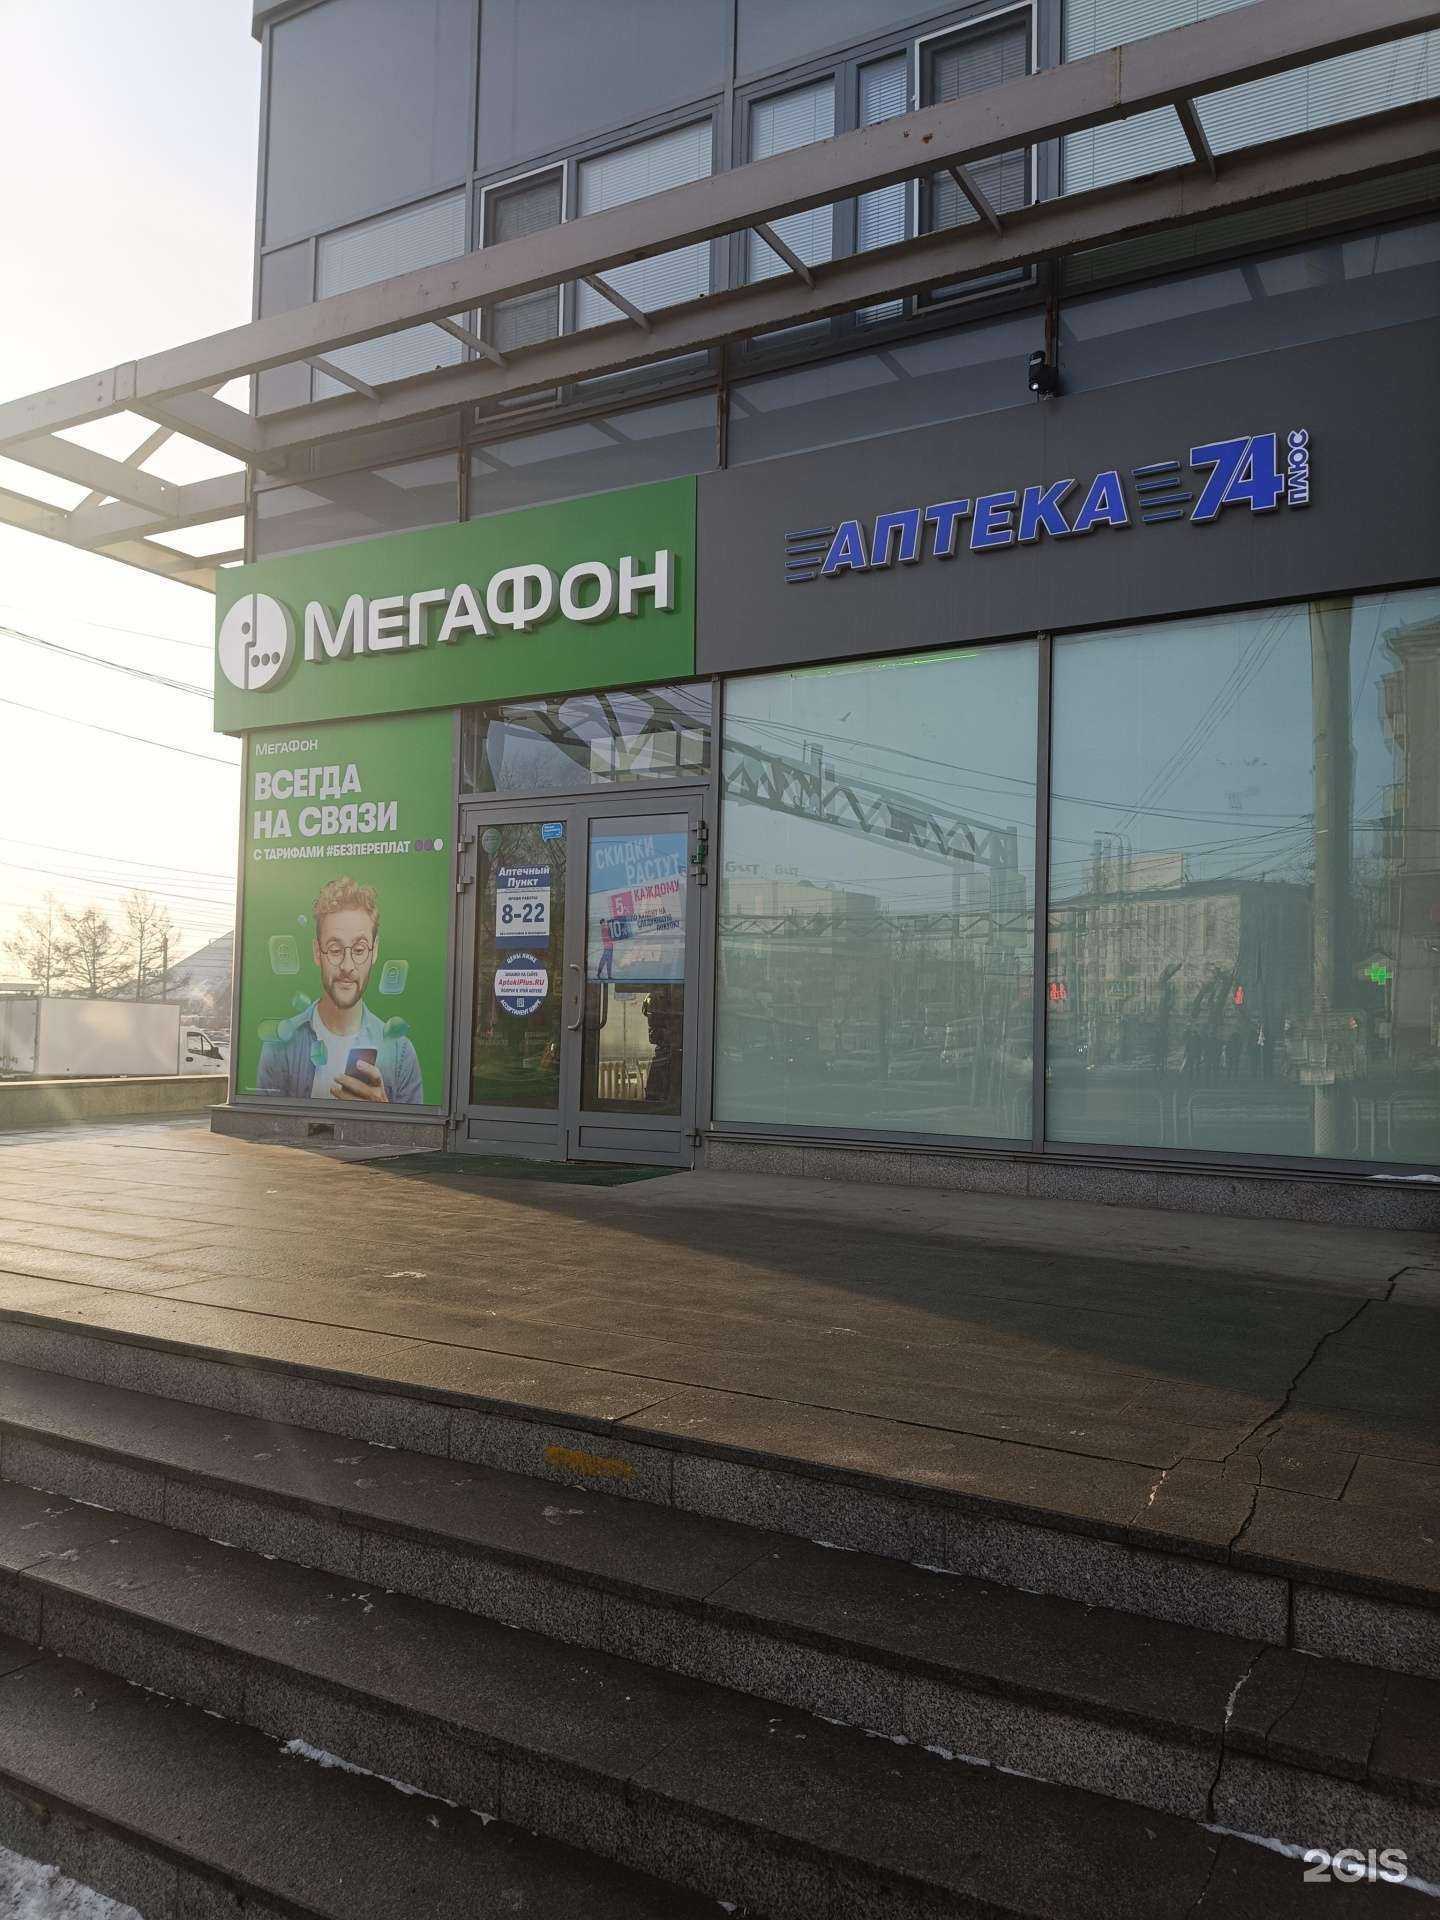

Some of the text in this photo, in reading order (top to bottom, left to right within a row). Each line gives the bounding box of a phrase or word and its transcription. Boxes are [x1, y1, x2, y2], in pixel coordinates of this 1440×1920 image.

[1286, 428, 1310, 506] ПЛЮС
[821, 433, 1285, 575] АПТЕКА 74
[254, 763, 362, 801] ВСЕГДА
[253, 801, 398, 840] НА СВЯЗИ
[253, 841, 411, 860] С ТАРИФАМИ #БЕЗПЕРЕПЛАТ
[596, 836, 654, 869] СКИДКИ
[499, 866, 550, 876] Аптечный
[507, 877, 539, 888] Пункт
[626, 853, 680, 886] РАСТУТ
[633, 880, 680, 902] КАЖДОМУ
[501, 903, 545, 924] 8-22
